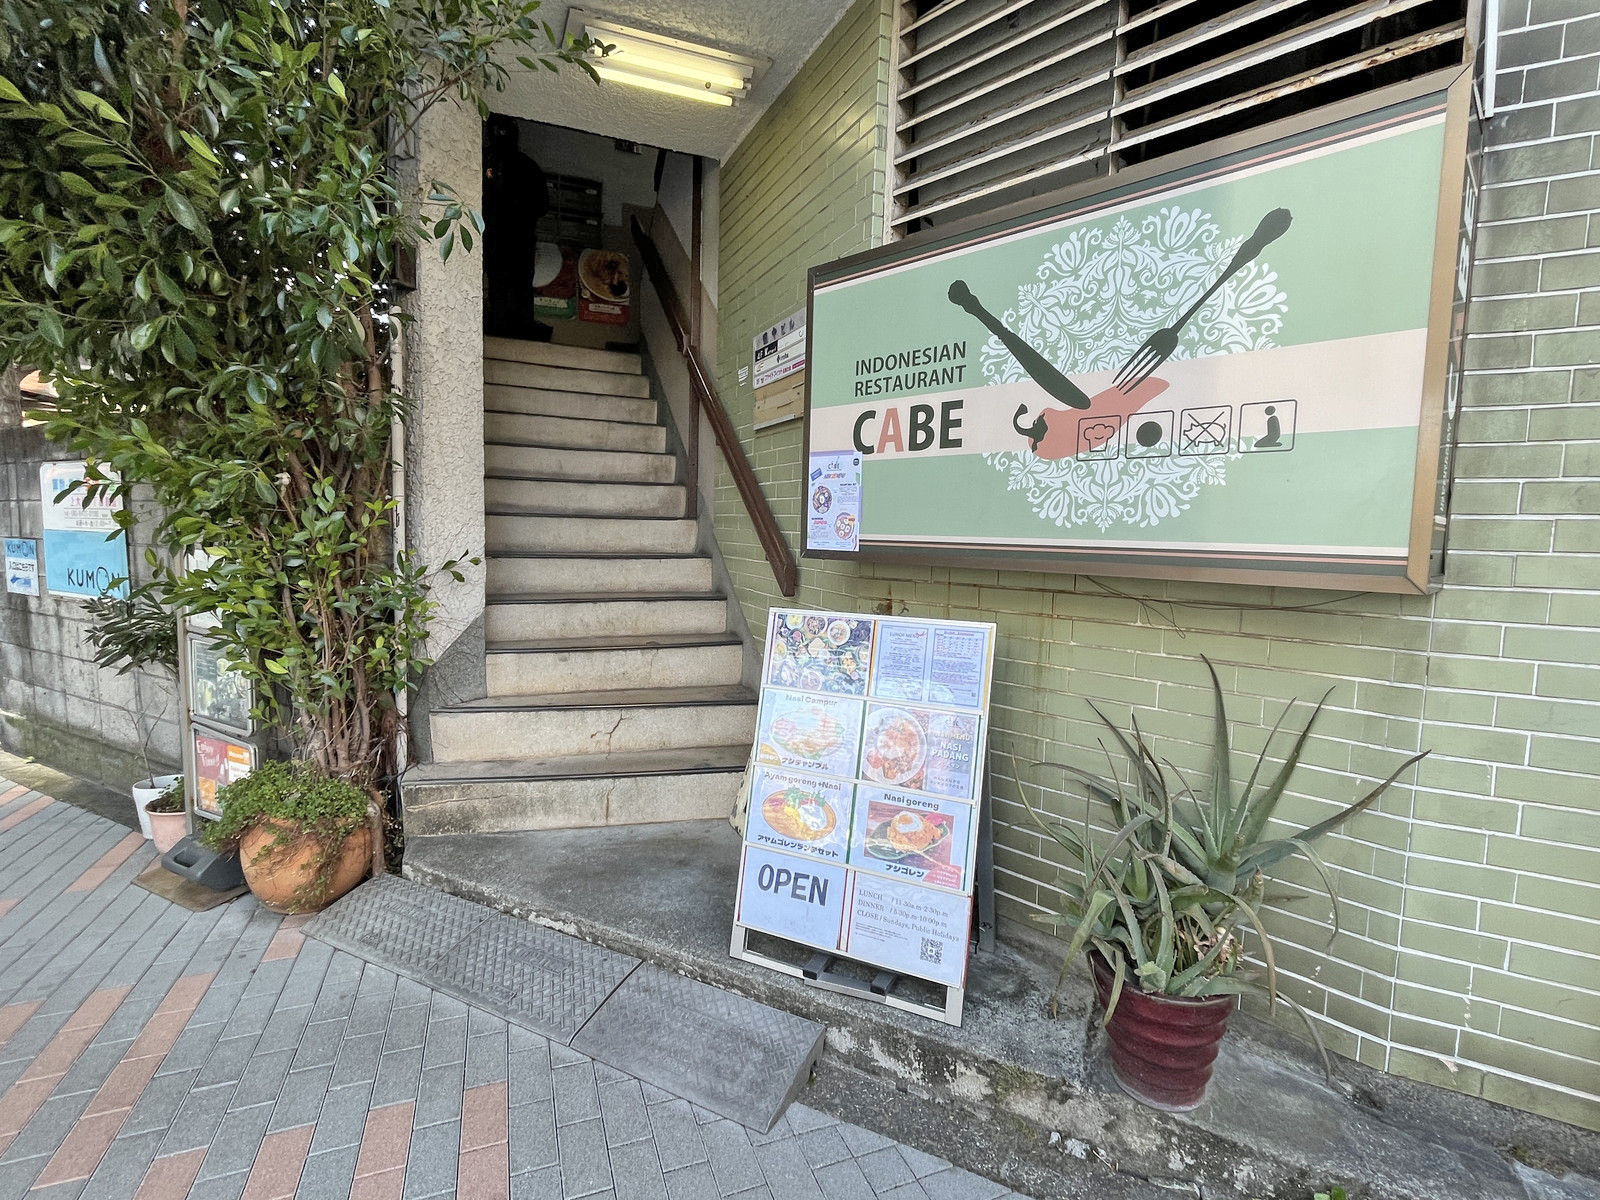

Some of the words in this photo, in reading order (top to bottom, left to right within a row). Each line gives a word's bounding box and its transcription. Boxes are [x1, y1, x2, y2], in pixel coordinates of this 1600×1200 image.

[855, 341, 967, 376] INDONESIAN
[854, 364, 967, 397] RESTAURANT
[852, 399, 964, 455] CABE
[7, 541, 35, 557] KUMON
[785, 694, 804, 702] Nasi
[805, 697, 838, 706] Campur
[931, 748, 969, 762] PADANG
[940, 741, 962, 752] NASI
[764, 771, 787, 782] Ayam
[788, 777, 817, 788] goreng
[883, 793, 905, 803] Nasi
[905, 799, 940, 811] goreng
[757, 834, 839, 858] アヤムゴレンランチセット
[885, 863, 925, 878] ナシゴレン
[757, 863, 829, 907] OPEN
[859, 889, 883, 901] LUNCH
[858, 899, 885, 911] DINNER
[856, 909, 879, 921] CLOSE
[911, 923, 931, 934] Public
[932, 929, 960, 942] Holidays
